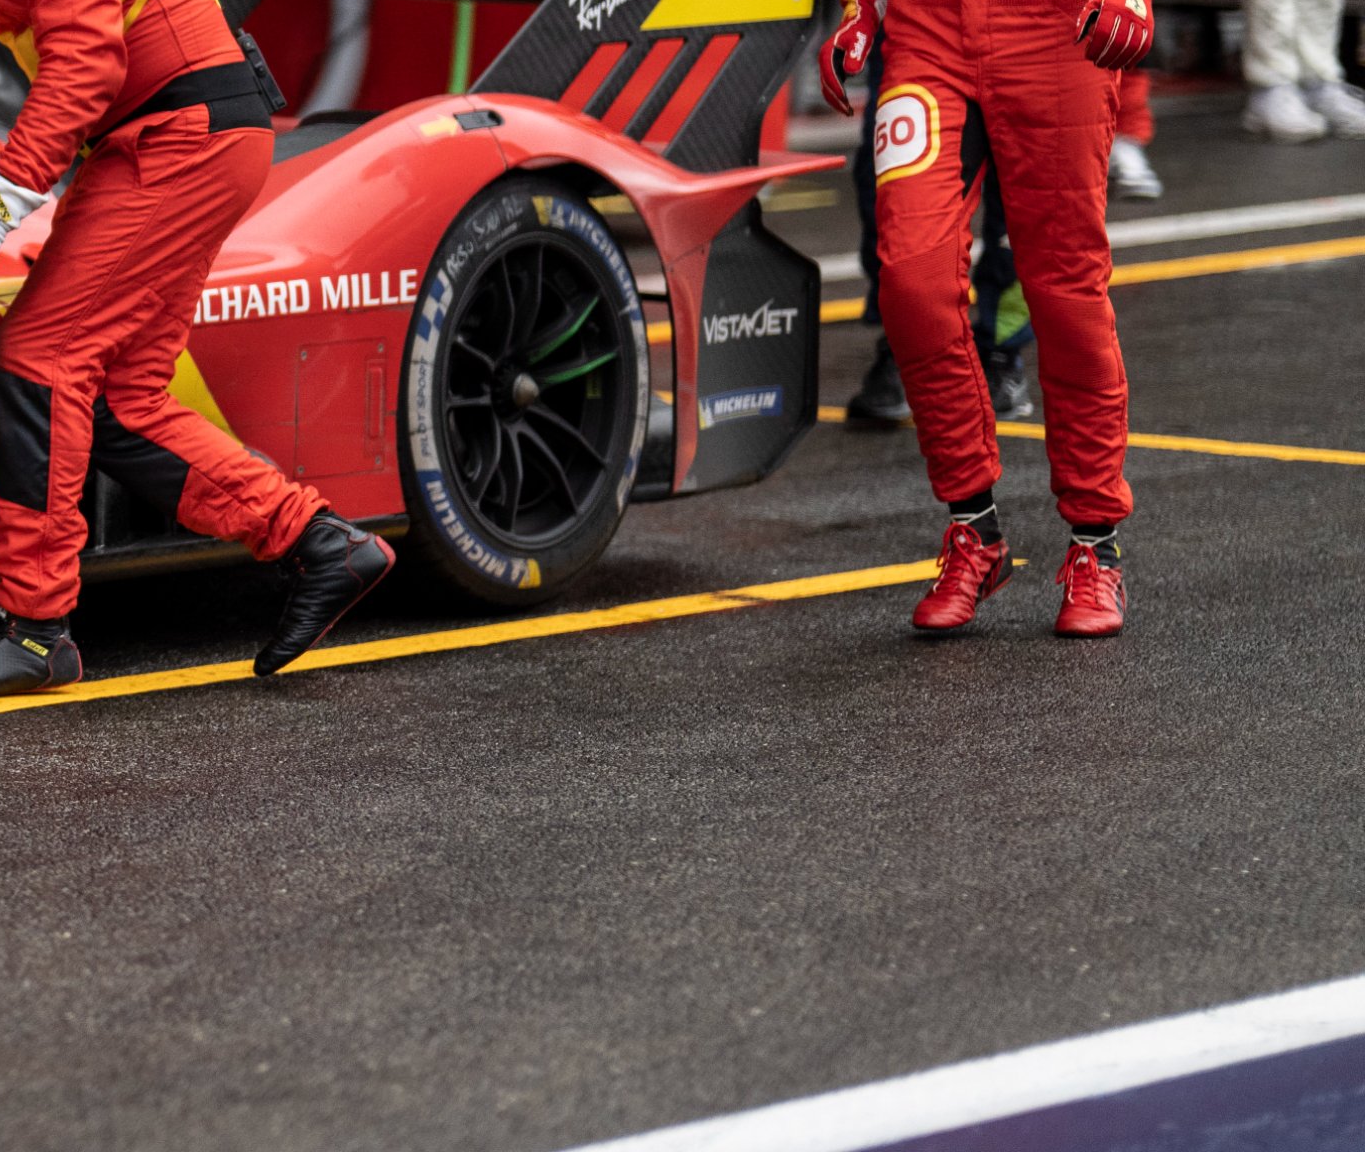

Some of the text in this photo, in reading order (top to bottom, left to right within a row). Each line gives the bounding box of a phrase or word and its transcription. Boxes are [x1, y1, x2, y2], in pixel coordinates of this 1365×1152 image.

[874, 115, 916, 151] 50
[193, 268, 418, 325] ICHARD MILLE
[703, 298, 799, 346] VISTAJET
[416, 359, 432, 458] PILOT SPORT
[713, 391, 777, 416] MICHELIN
[426, 480, 506, 580] MICHELIN
